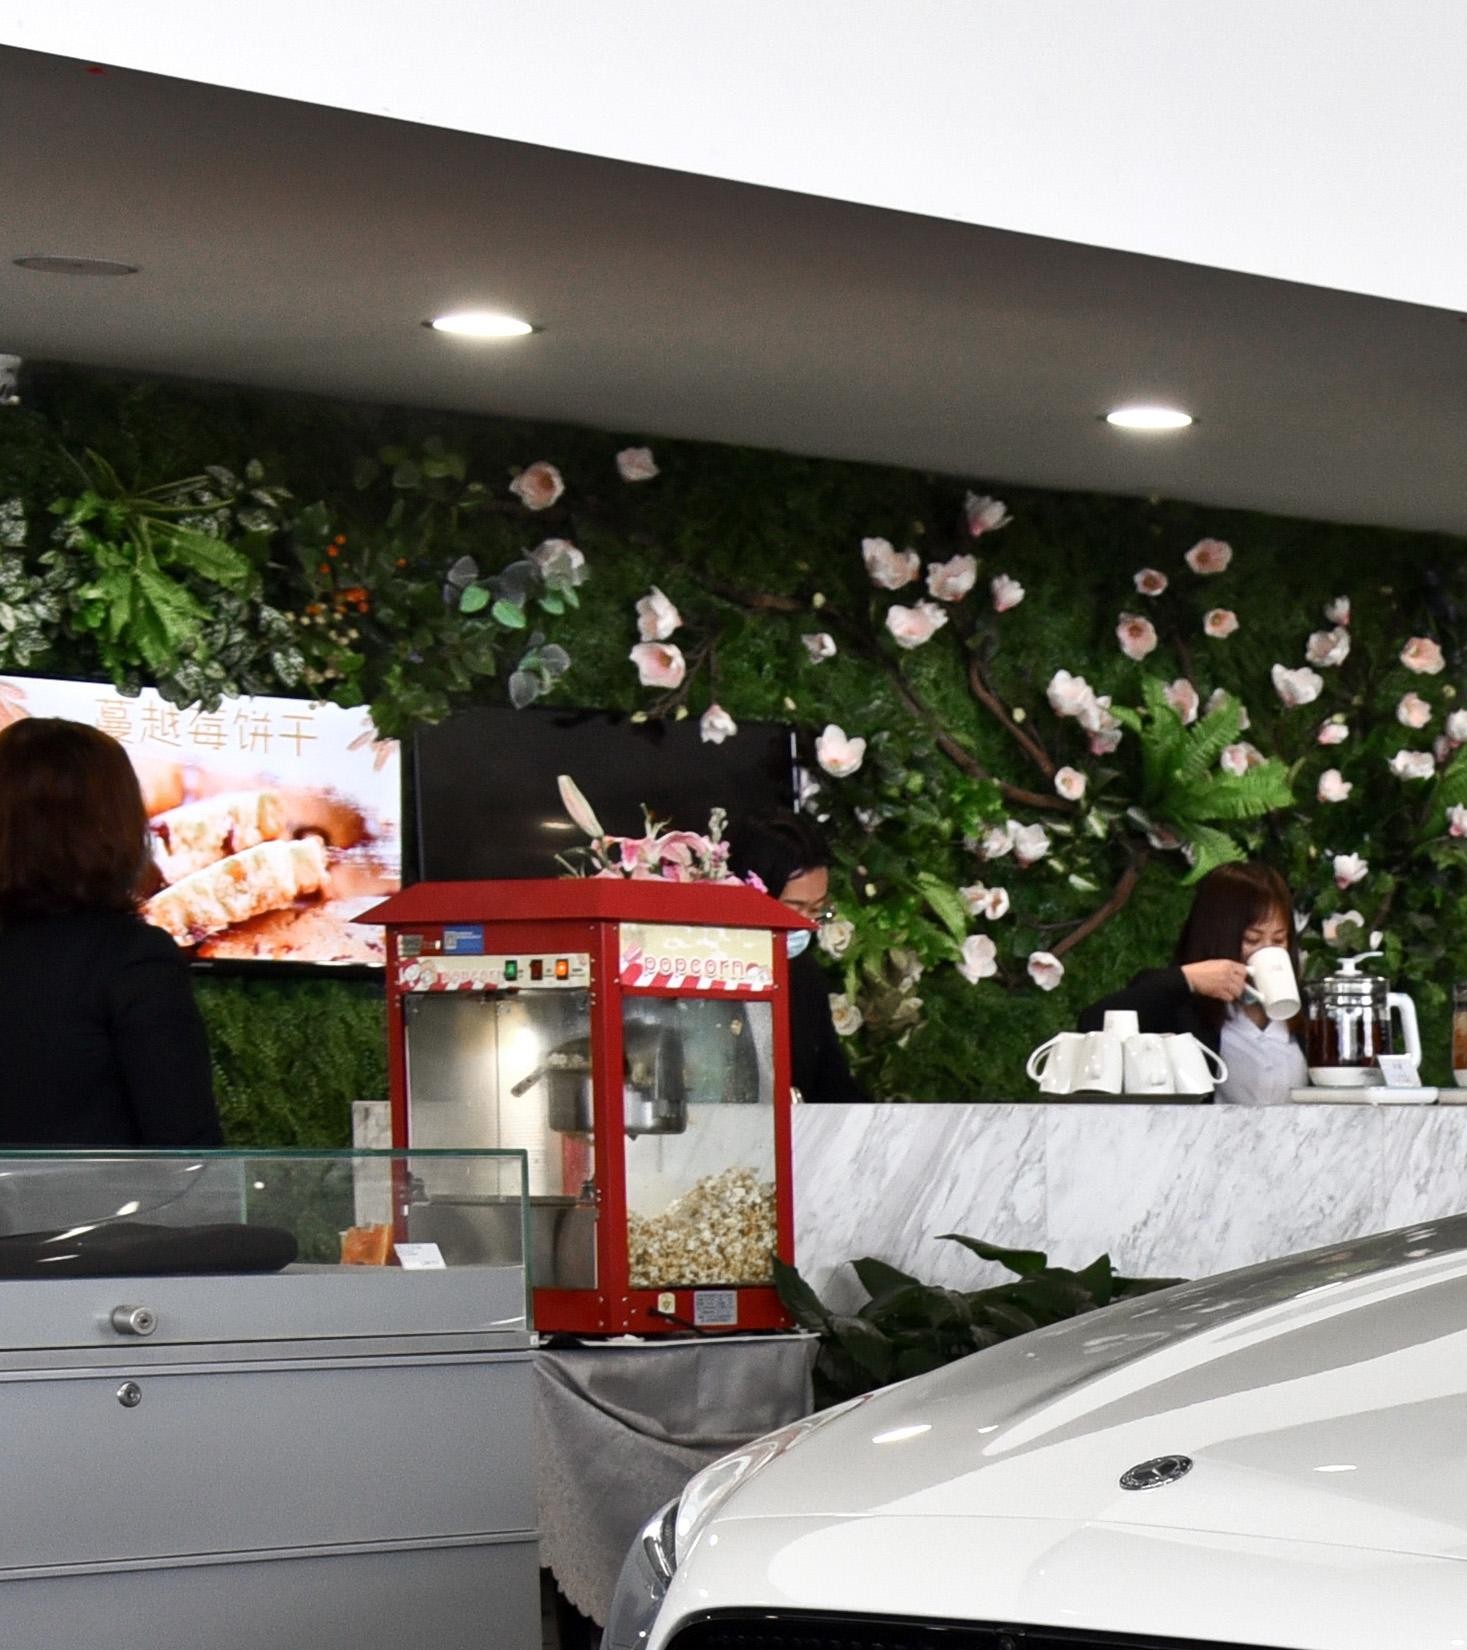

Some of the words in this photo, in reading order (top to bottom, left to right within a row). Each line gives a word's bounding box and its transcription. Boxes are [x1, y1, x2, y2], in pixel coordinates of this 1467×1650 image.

[95, 698, 319, 757] 蔓越莓饼干
[644, 956, 745, 978] popcorn
